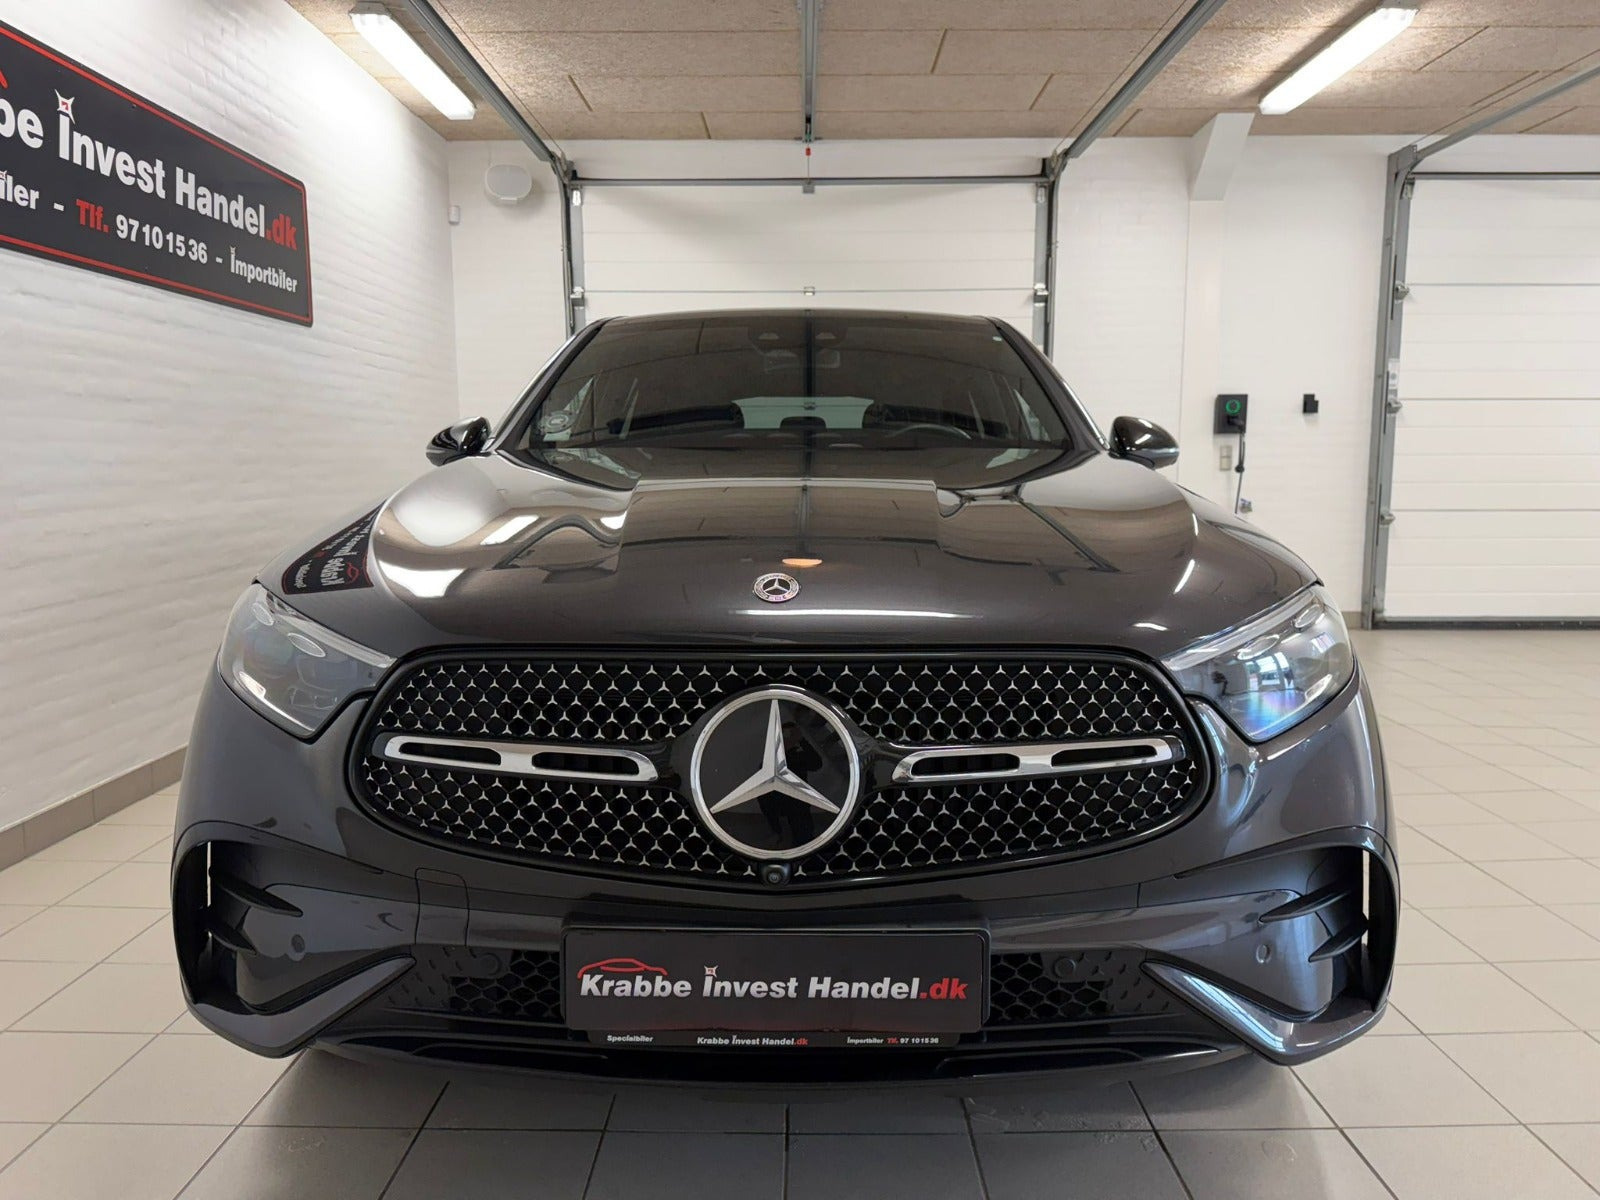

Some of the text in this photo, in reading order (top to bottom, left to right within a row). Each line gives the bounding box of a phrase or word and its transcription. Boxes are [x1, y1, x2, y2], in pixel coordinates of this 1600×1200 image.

[55, 89, 166, 200] Invest
[176, 166, 297, 251] Handel.dk
[76, 198, 109, 233] Tlf.
[230, 246, 298, 293] Importbiler
[580, 965, 969, 1000] Krabbe Invest Handel.dk
[606, 1034, 654, 1043] Specialbiler
[697, 1034, 808, 1046] Krabbe Invest Handel.dk
